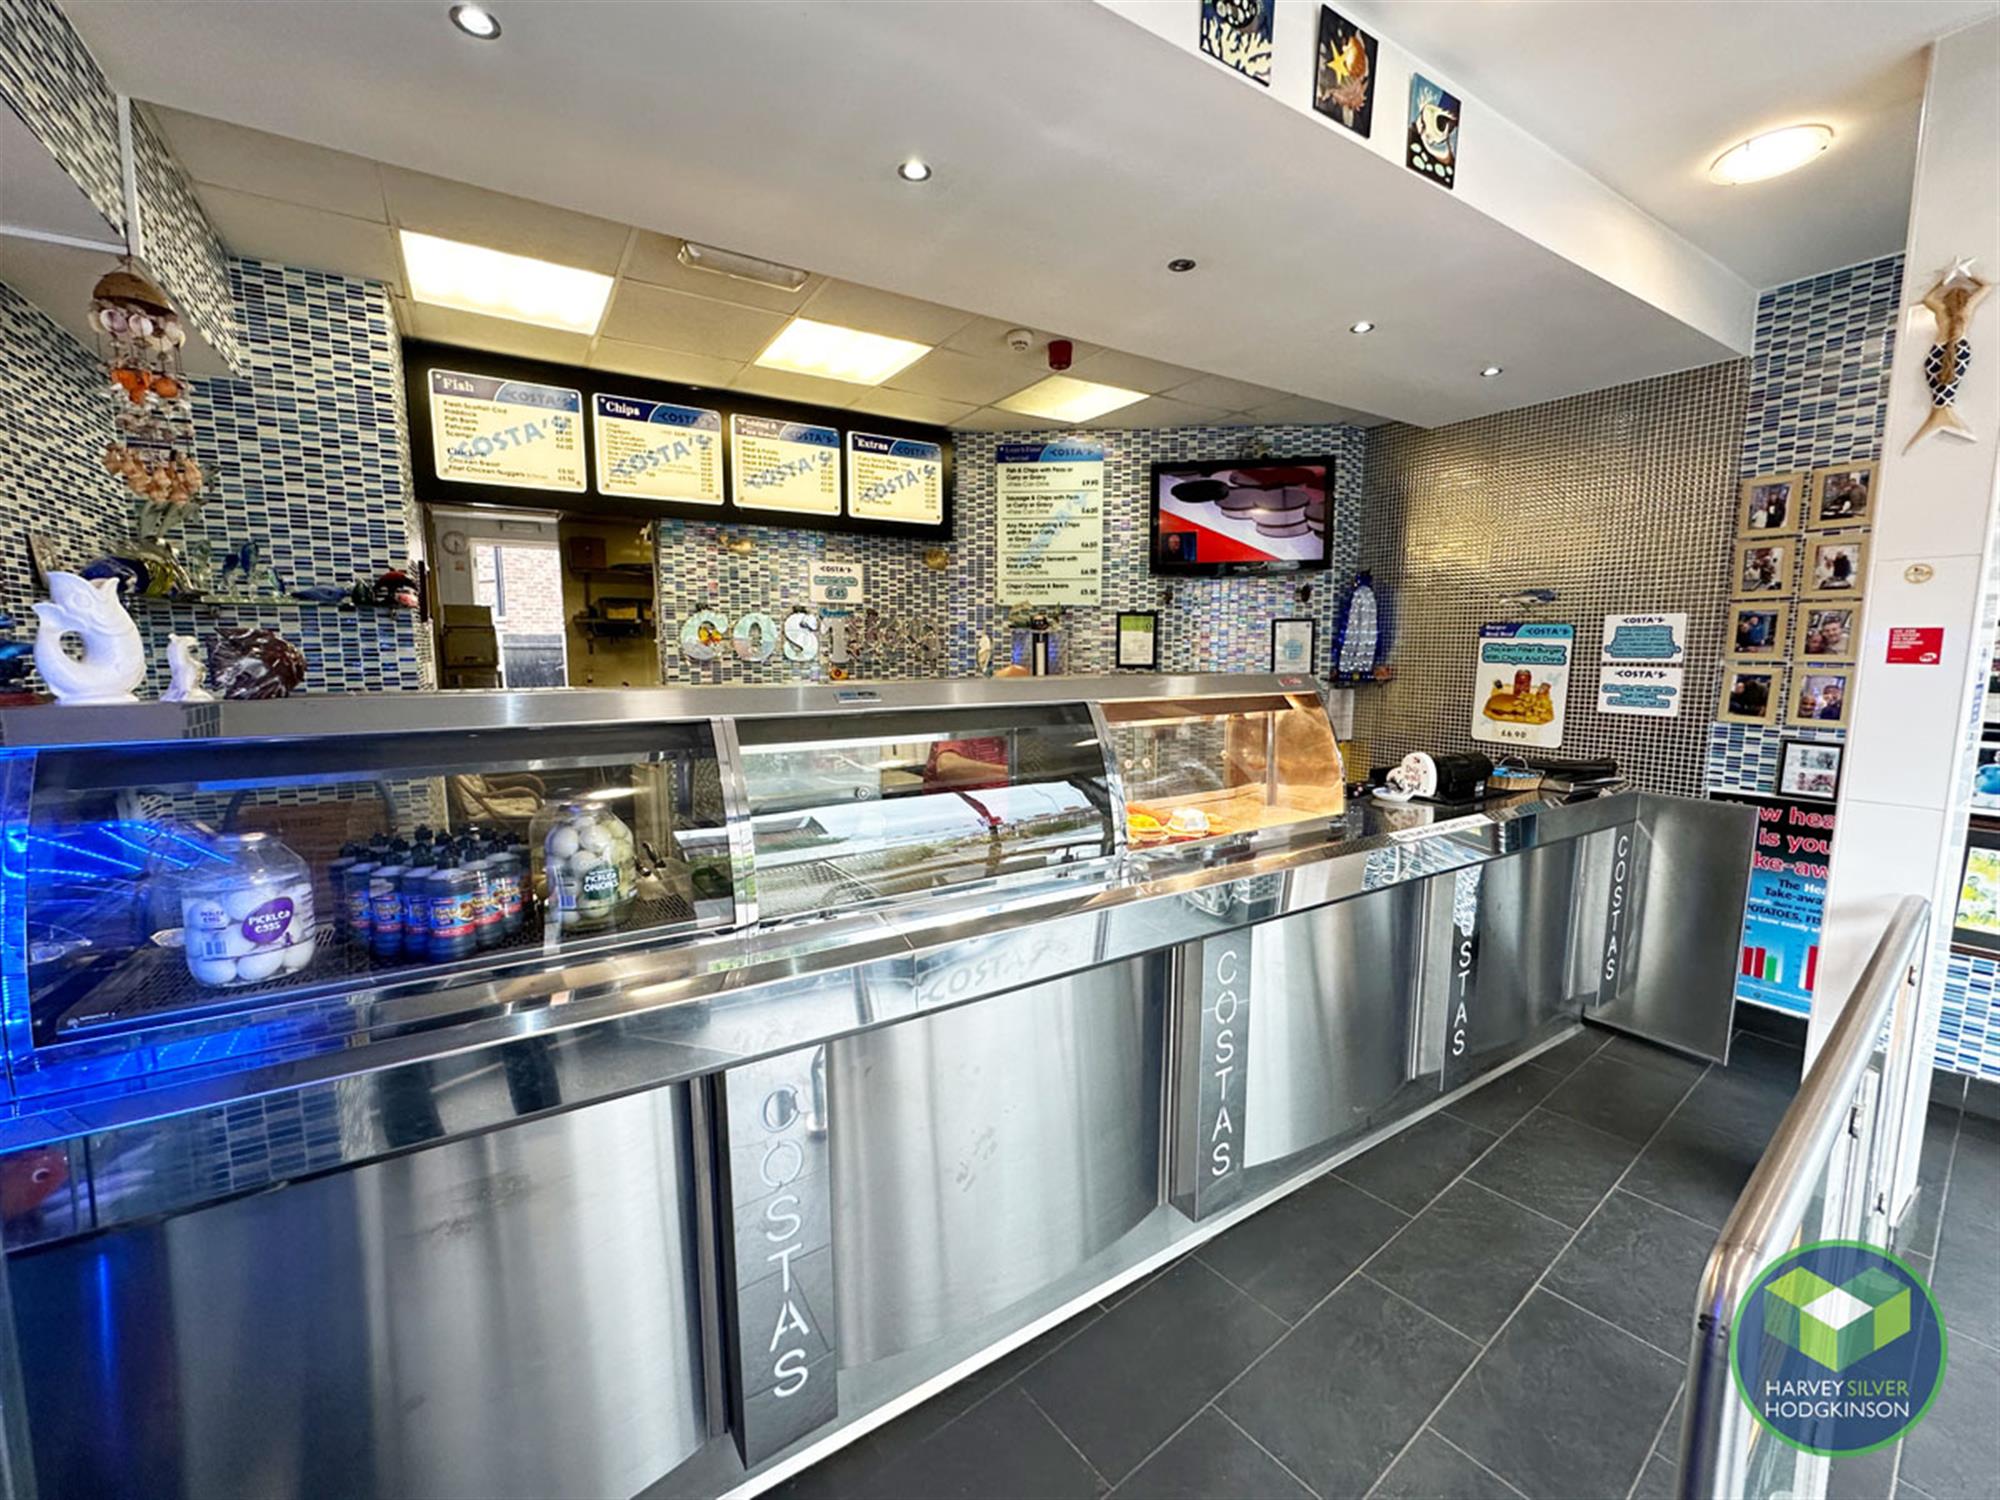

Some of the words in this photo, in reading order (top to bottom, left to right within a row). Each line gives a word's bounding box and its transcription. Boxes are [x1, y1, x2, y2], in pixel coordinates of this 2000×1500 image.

[442, 377, 475, 392] Fish
[606, 401, 640, 417] Chips
[858, 439, 888, 451] Extras
[1622, 616, 1665, 624] COSTA'S
[1526, 627, 1569, 636] COSTA'S
[1615, 670, 1667, 679] COSTA'S
[1789, 806, 1835, 829] hea
[1759, 827, 1780, 847] is
[1787, 834, 1831, 855] you
[1753, 851, 1829, 879] ke-aw
[1765, 885, 1824, 905] Take-awa
[1778, 878, 1801, 891] The
[1804, 883, 1825, 895] Hea
[1605, 835, 1629, 980] COSTAS
[1748, 904, 1803, 923] OTATOES,
[1805, 914, 1822, 925] FIS
[1452, 918, 1473, 1056] STAS
[1211, 950, 1238, 1176] COSTAS
[760, 1083, 810, 1397] COSTAS
